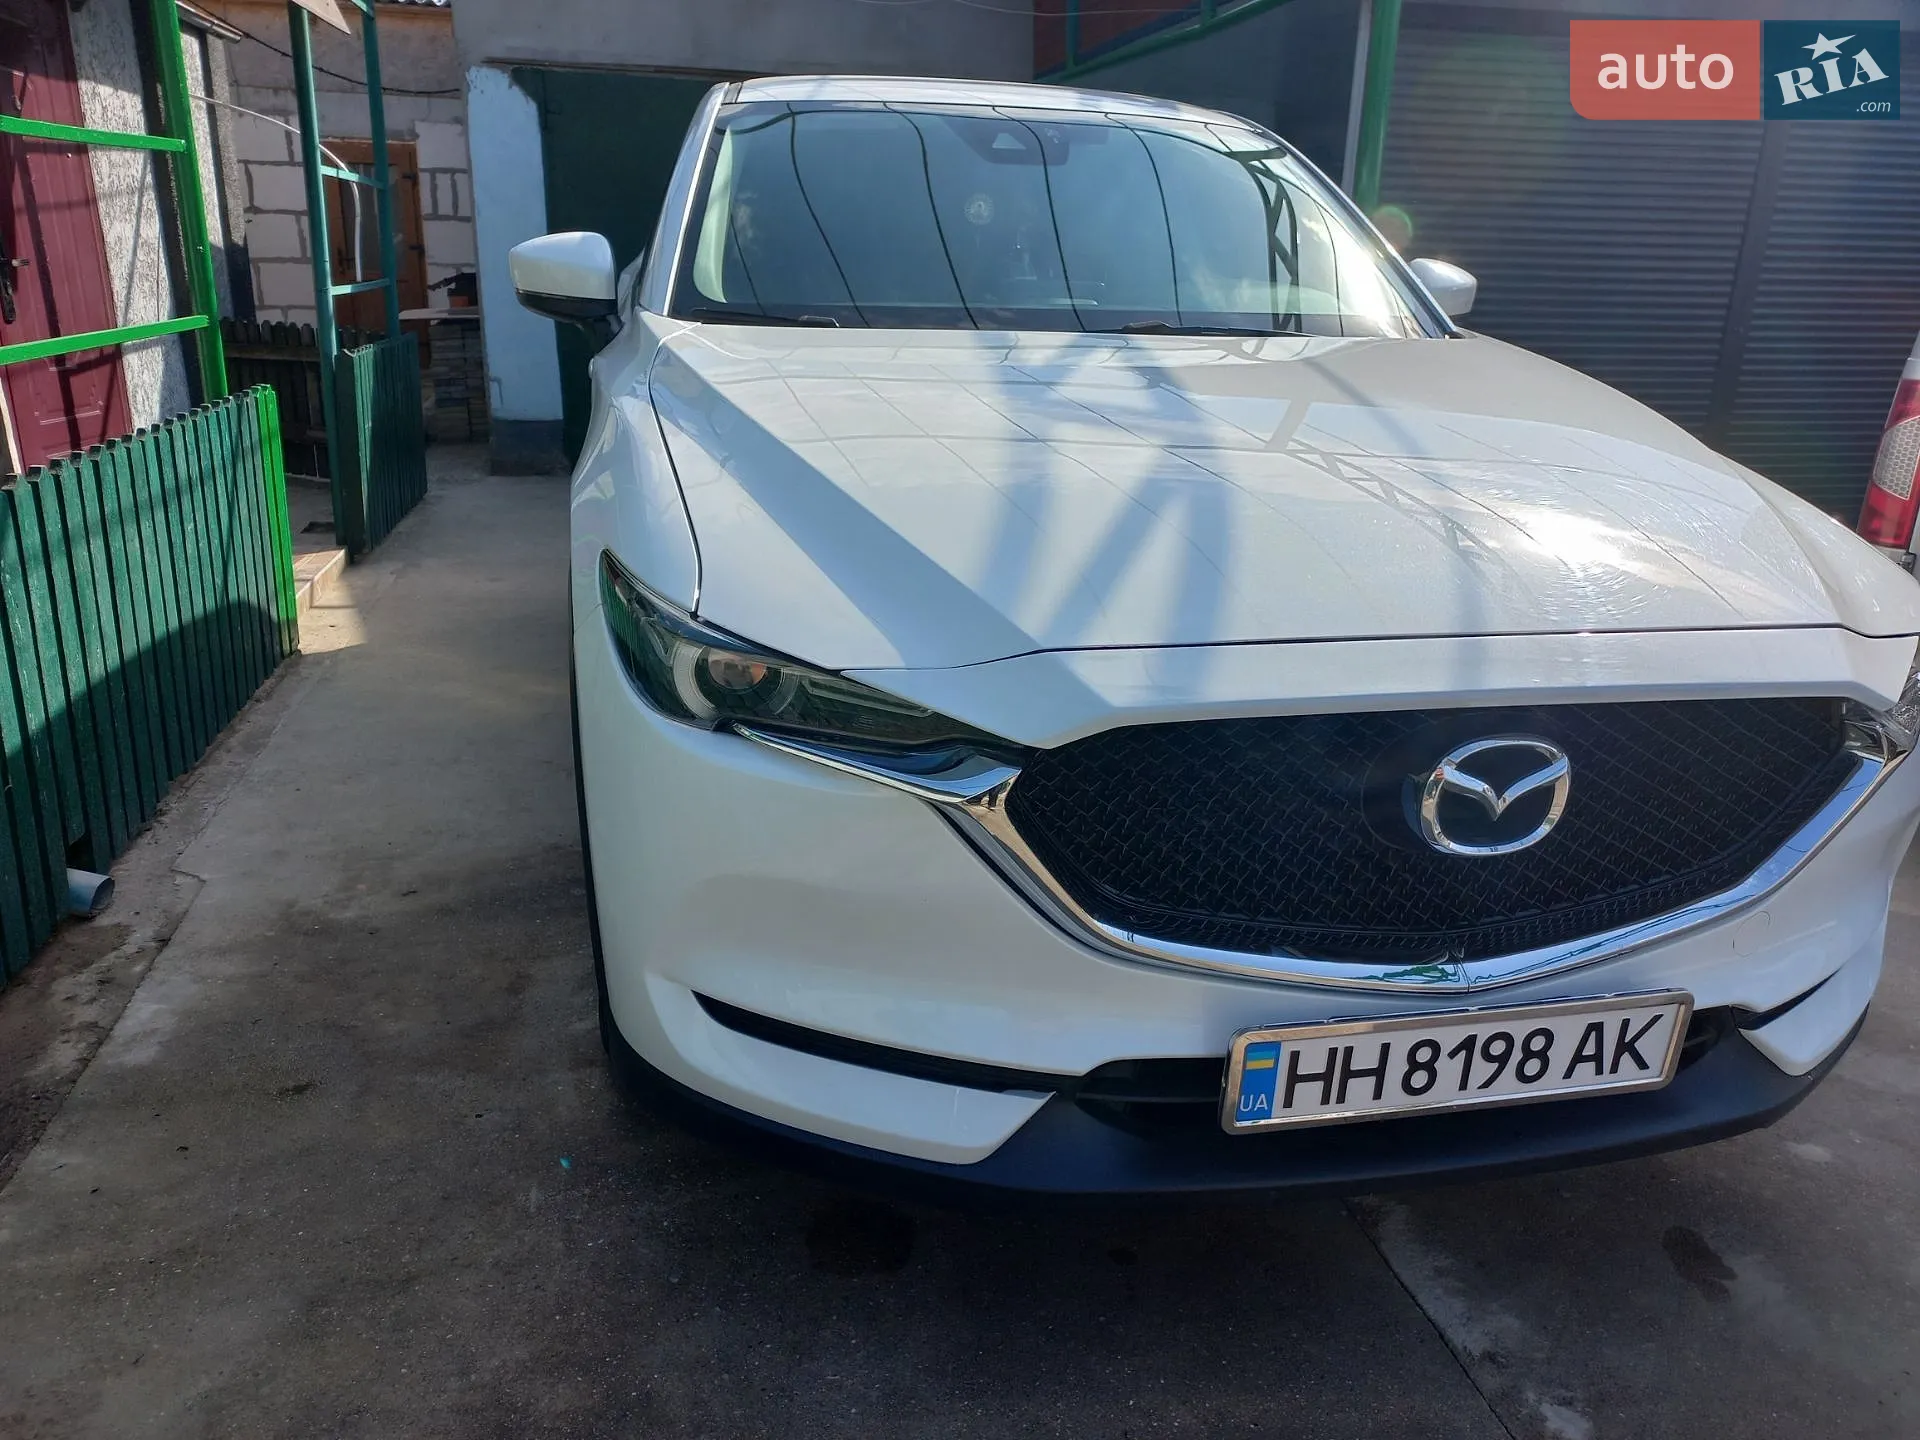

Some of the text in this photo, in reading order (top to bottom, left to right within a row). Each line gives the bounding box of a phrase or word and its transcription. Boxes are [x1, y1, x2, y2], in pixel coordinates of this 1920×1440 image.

[1282, 1013, 1664, 1109] HH 8198 AK
[1240, 1093, 1268, 1112] UA
